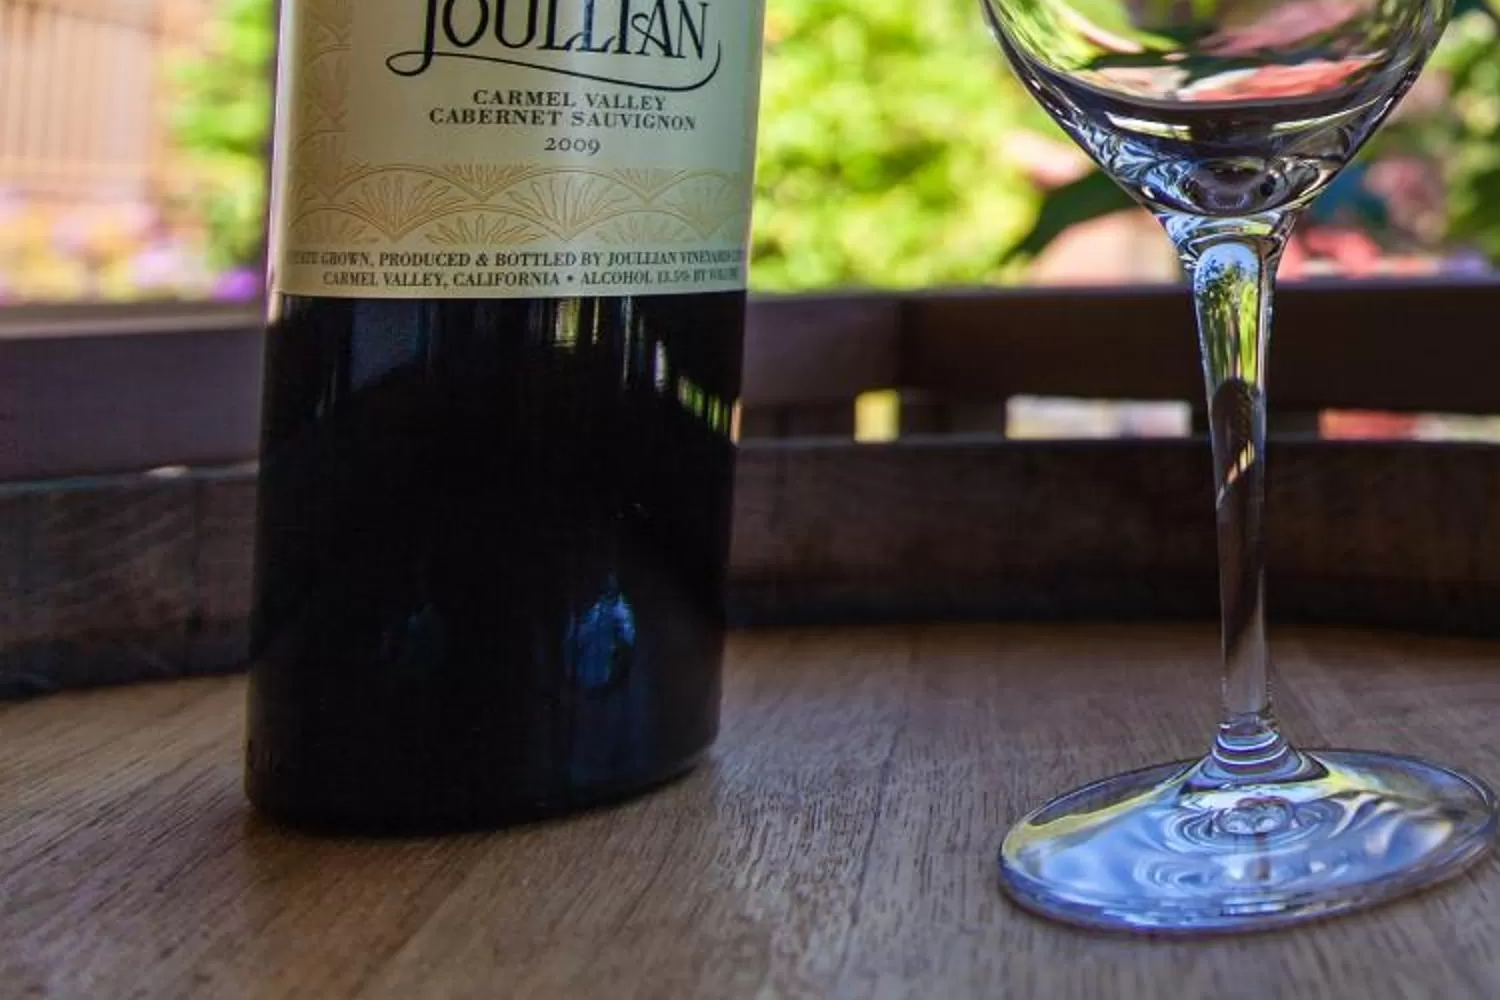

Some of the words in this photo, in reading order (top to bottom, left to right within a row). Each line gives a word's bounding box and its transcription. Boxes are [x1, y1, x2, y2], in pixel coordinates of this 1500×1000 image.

[473, 89, 577, 108] CARMEL
[585, 93, 666, 111] VALLEY
[429, 108, 563, 126] CABERNET
[571, 112, 696, 131] SAUVIGNON
[544, 137, 600, 155] 2009
[320, 252, 374, 267] GROWN,
[379, 252, 471, 267] PRODUCED
[475, 253, 489, 267] &
[495, 252, 576, 267] BOTTLED
[580, 251, 600, 266] BY
[607, 250, 677, 266] JOULLIAN
[323, 271, 378, 286] CARMEL
[384, 272, 448, 290] VALLEY,
[453, 271, 560, 287] CALIFORNIA
[580, 270, 652, 285] ALCOHOL
